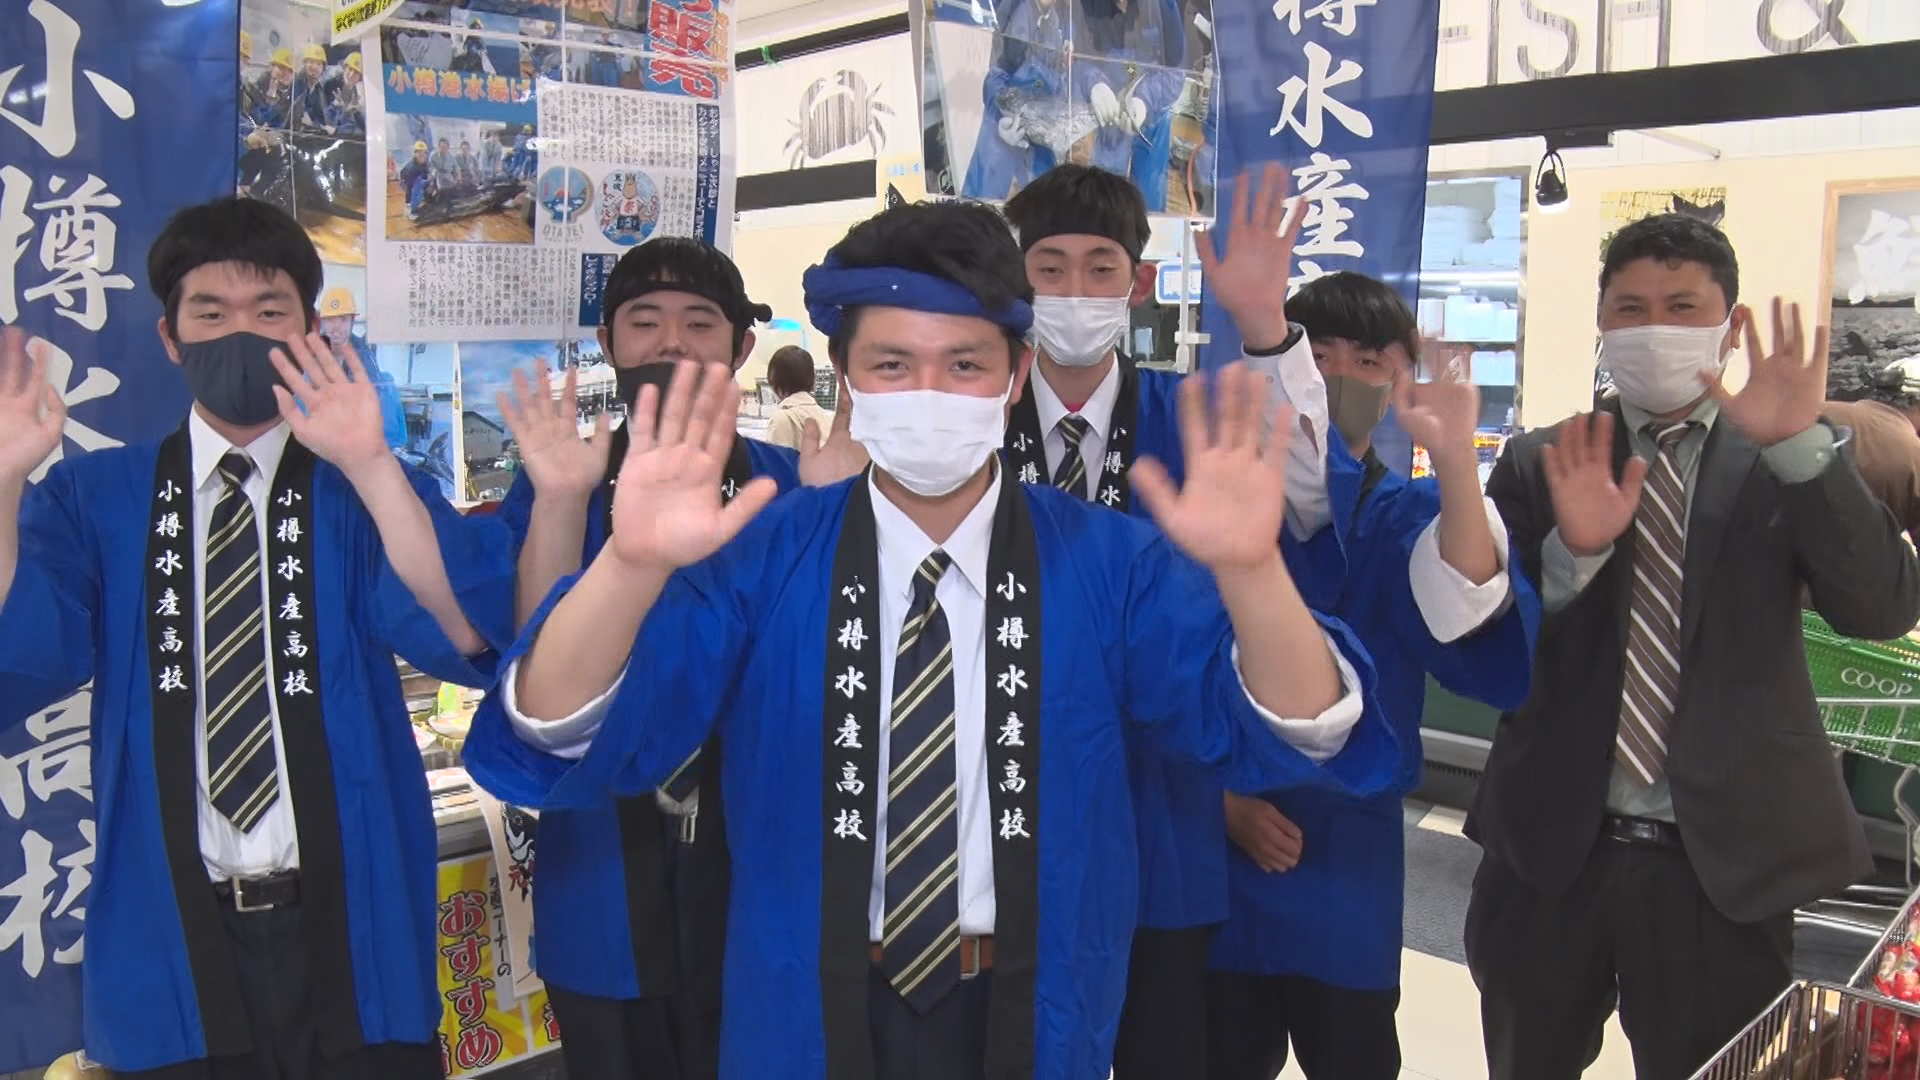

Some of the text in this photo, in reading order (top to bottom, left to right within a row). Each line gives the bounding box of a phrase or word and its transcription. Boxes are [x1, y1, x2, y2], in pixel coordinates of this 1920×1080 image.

[155, 479, 188, 692] 小樽水産高校
[276, 488, 314, 696] 小樽水産高校
[834, 575, 869, 842] 小樽水産高校
[996, 571, 1031, 841] 小樽水産高校
[440, 888, 504, 1070] おすすめ
